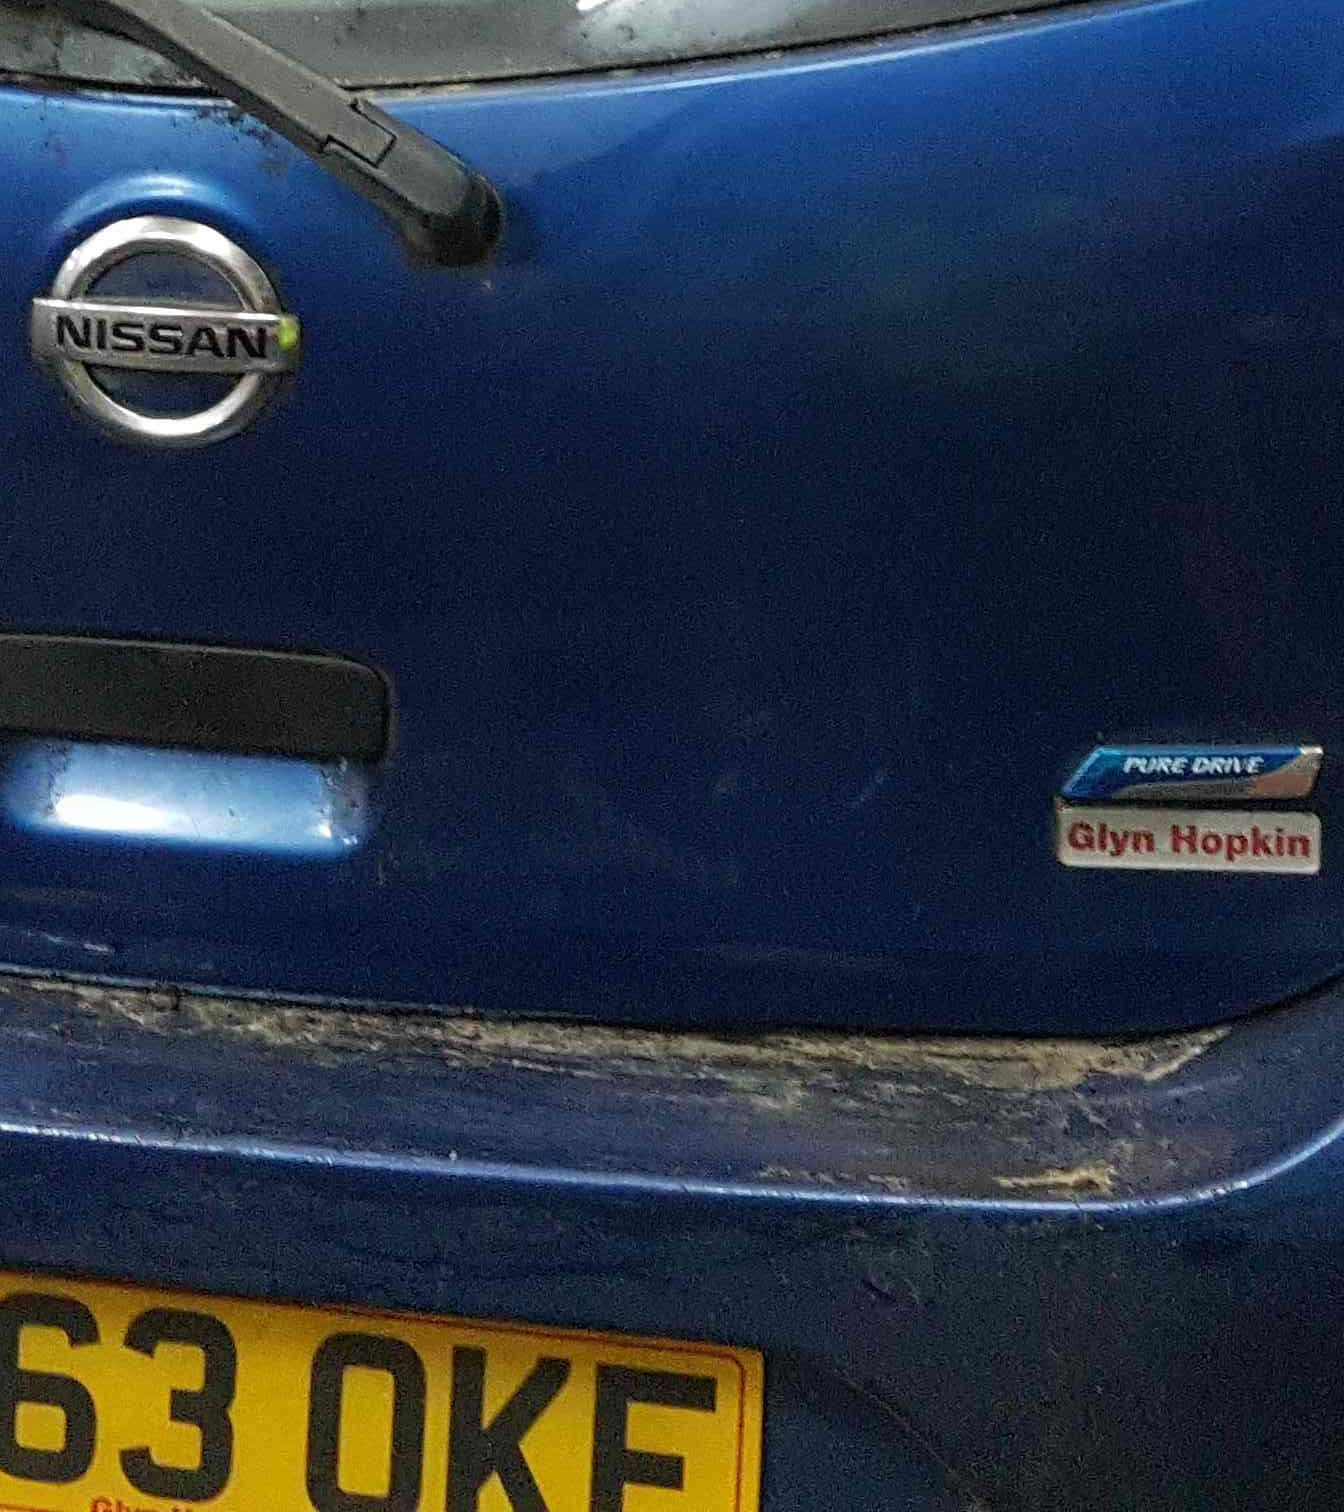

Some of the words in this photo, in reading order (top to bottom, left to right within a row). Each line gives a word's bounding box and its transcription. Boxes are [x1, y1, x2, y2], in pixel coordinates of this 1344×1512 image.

[56, 314, 267, 359] NISSAN
[1122, 755, 1185, 775] PURE
[1191, 756, 1265, 775] DRIVE
[1066, 820, 1155, 857] Glyn
[1170, 823, 1312, 862] Hopkin
[305, 1331, 718, 1512] OKF
